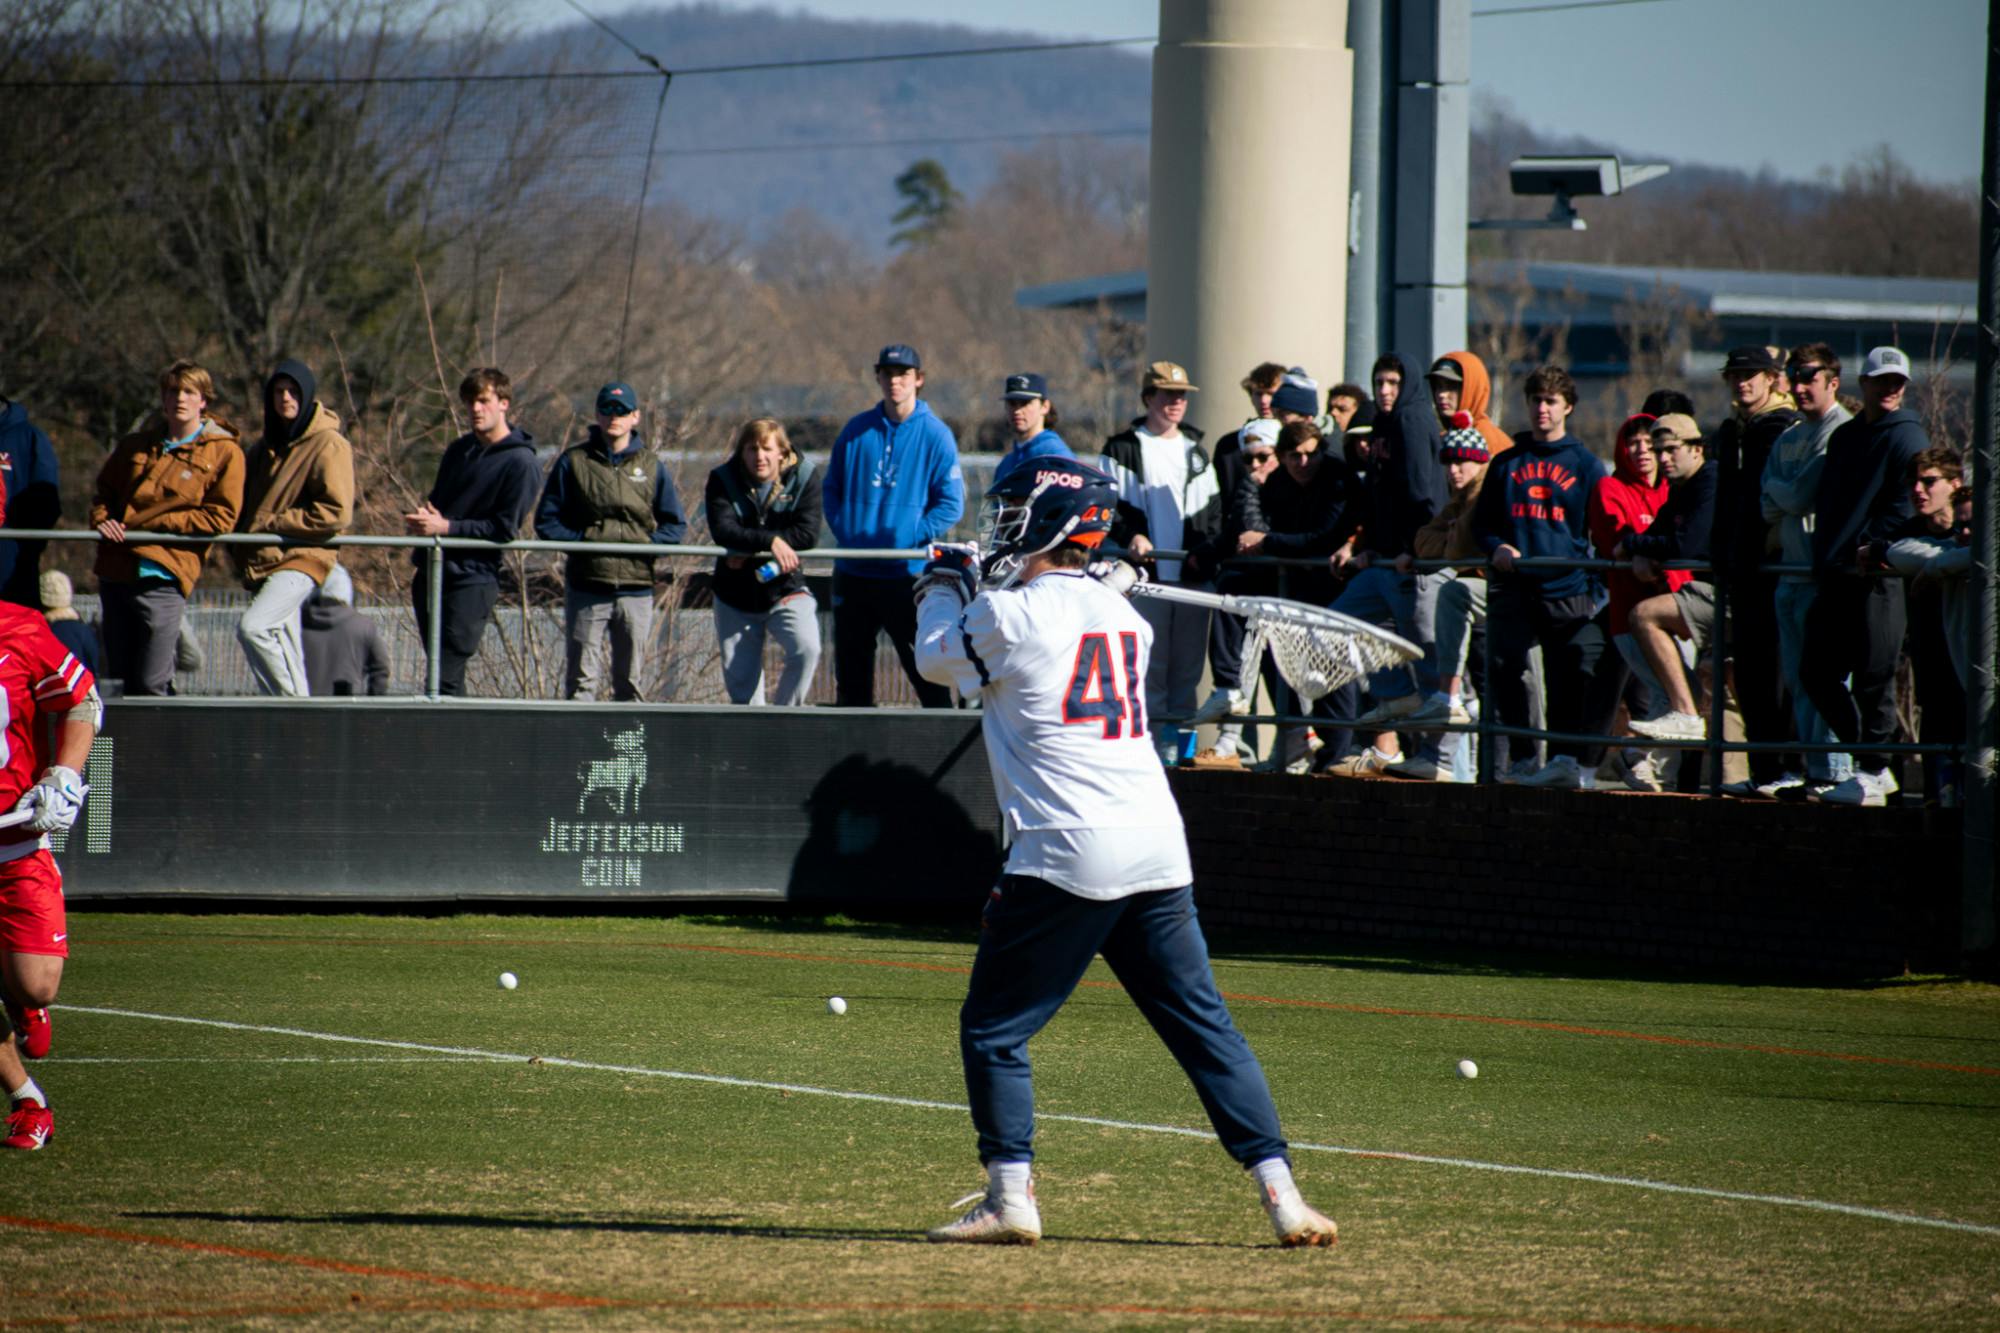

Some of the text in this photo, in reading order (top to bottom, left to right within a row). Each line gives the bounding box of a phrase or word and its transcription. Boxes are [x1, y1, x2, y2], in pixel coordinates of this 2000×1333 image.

[1035, 470, 1084, 489] HOOS
[1510, 460, 1577, 491] VIRGINIA
[1061, 631, 1143, 740] 41
[540, 817, 685, 852] JEFFERSON
